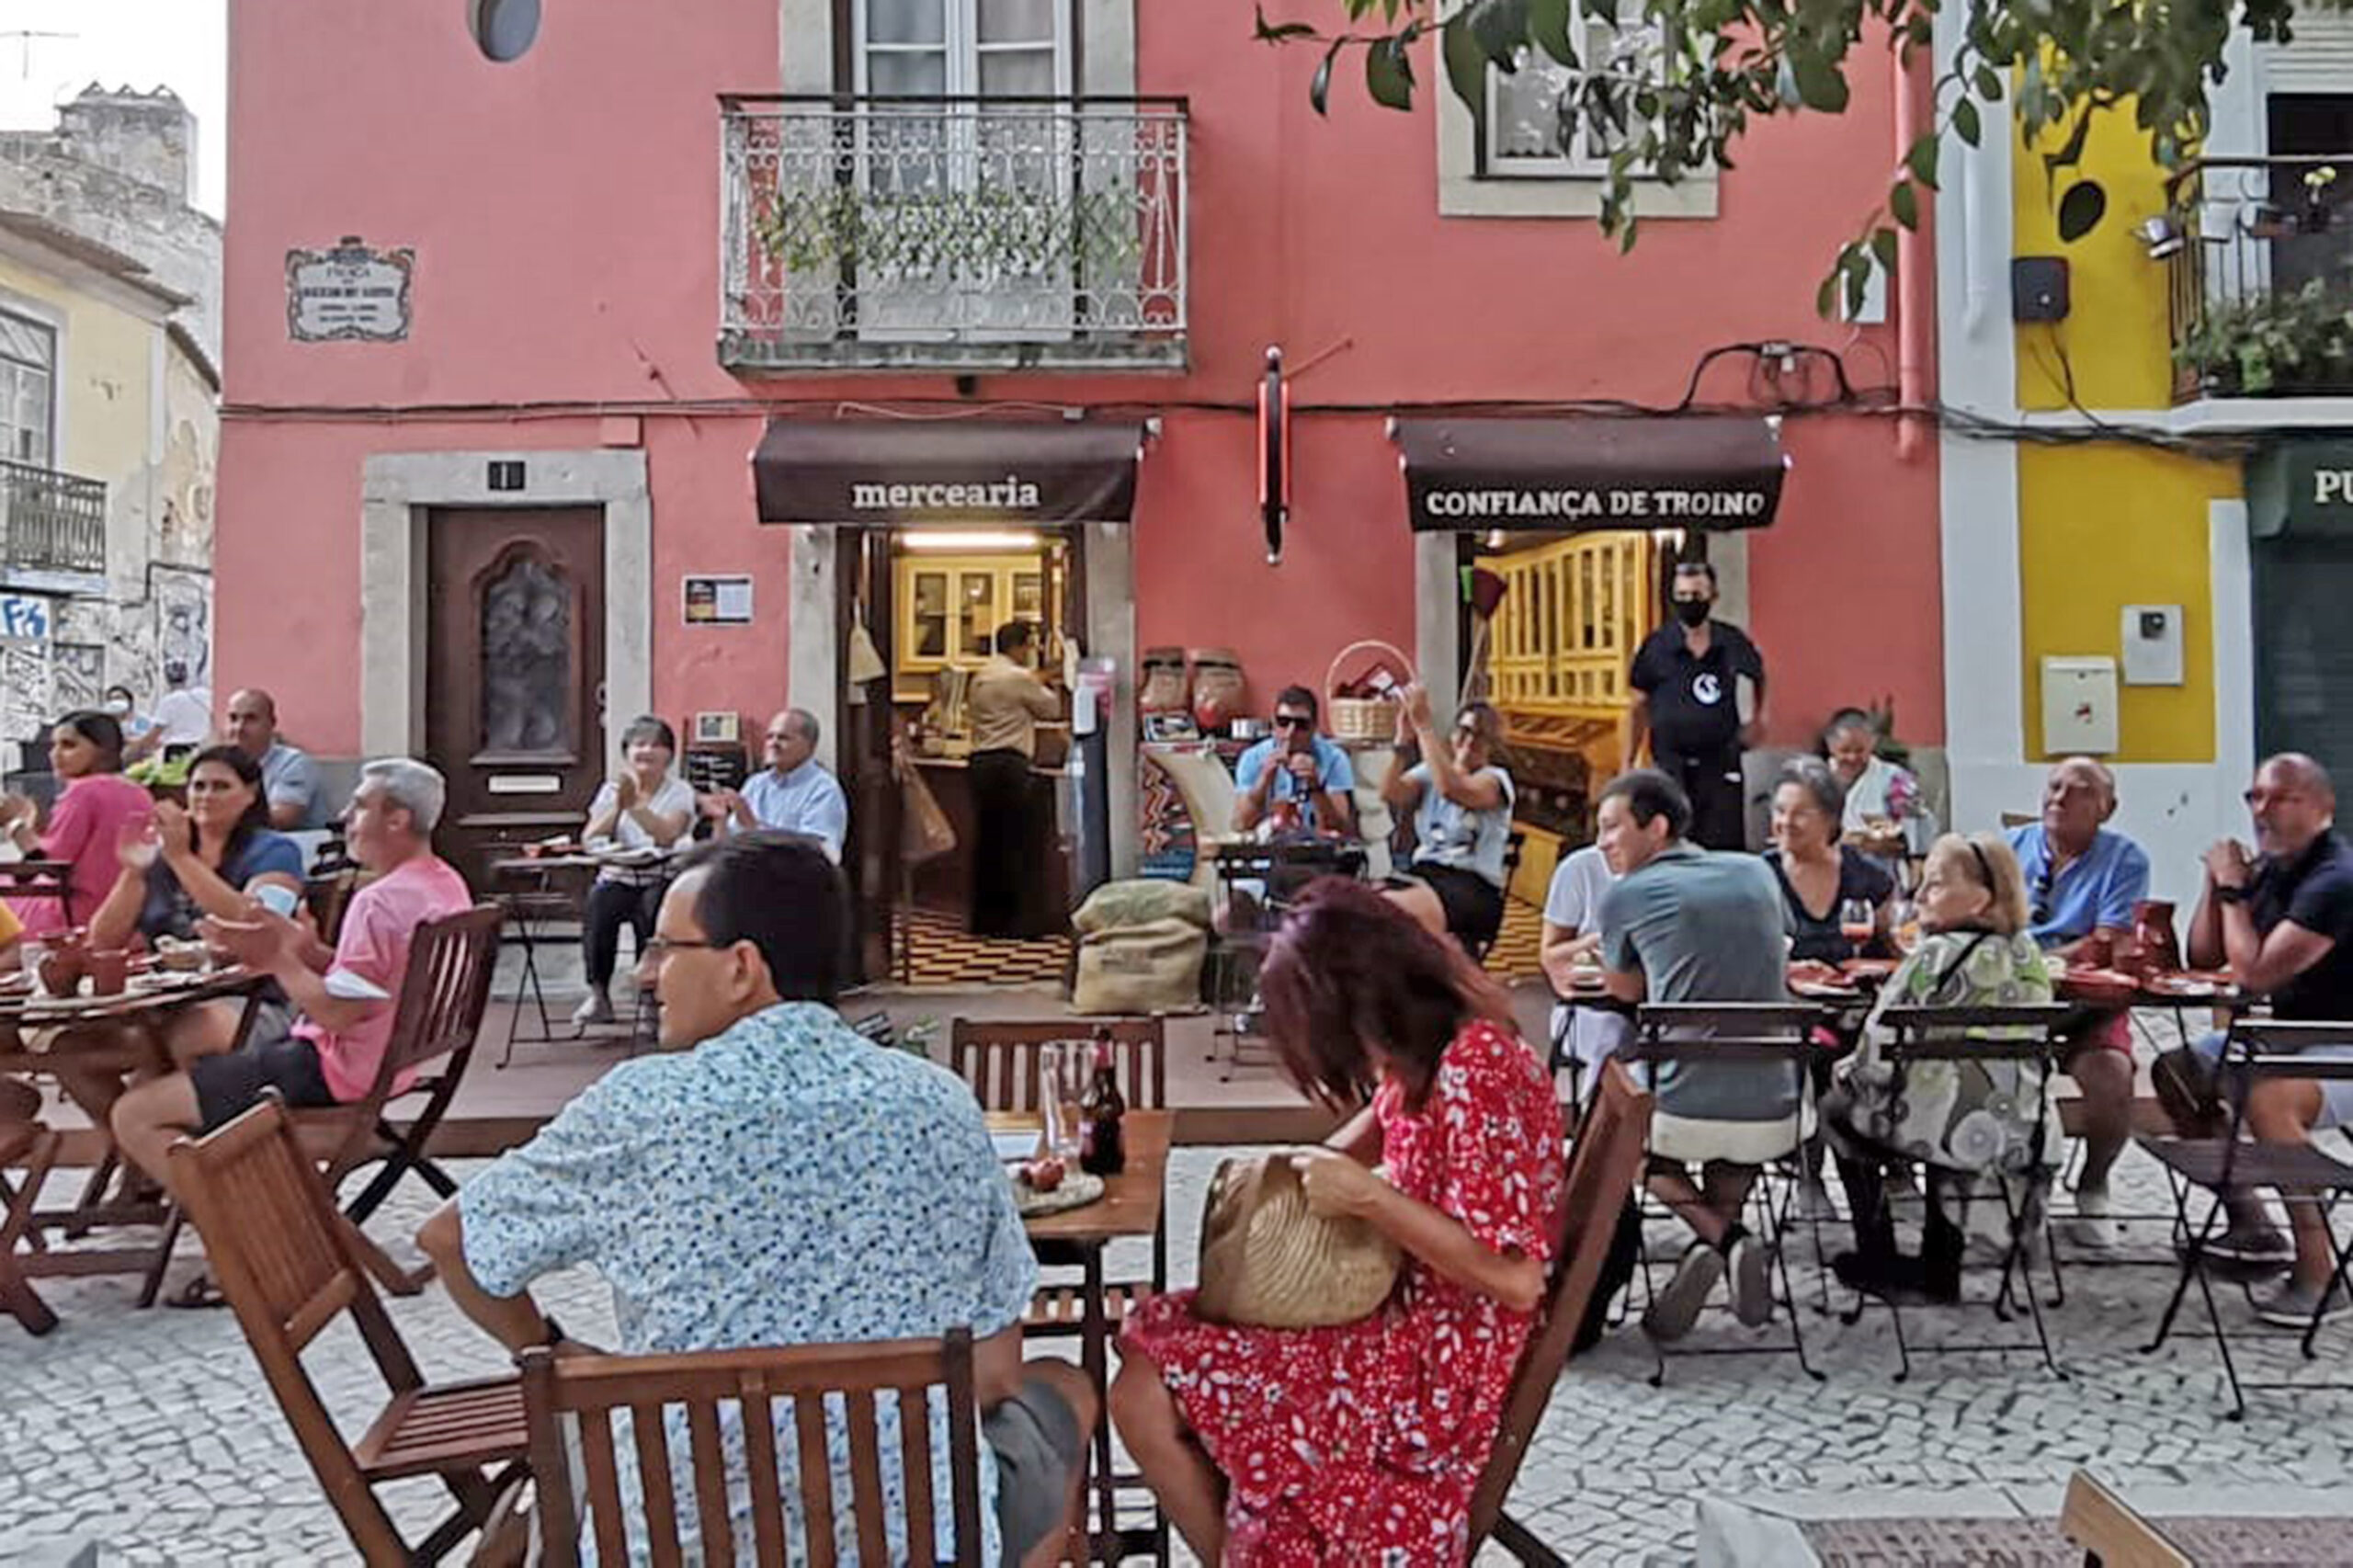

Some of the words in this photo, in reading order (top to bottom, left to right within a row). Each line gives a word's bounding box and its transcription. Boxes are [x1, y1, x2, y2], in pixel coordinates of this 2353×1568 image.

[853, 474, 1040, 508] mercearia
[1427, 490, 1603, 520] CONFIANÇA
[1608, 491, 1650, 516] DE
[1654, 492, 1765, 517] TROINO
